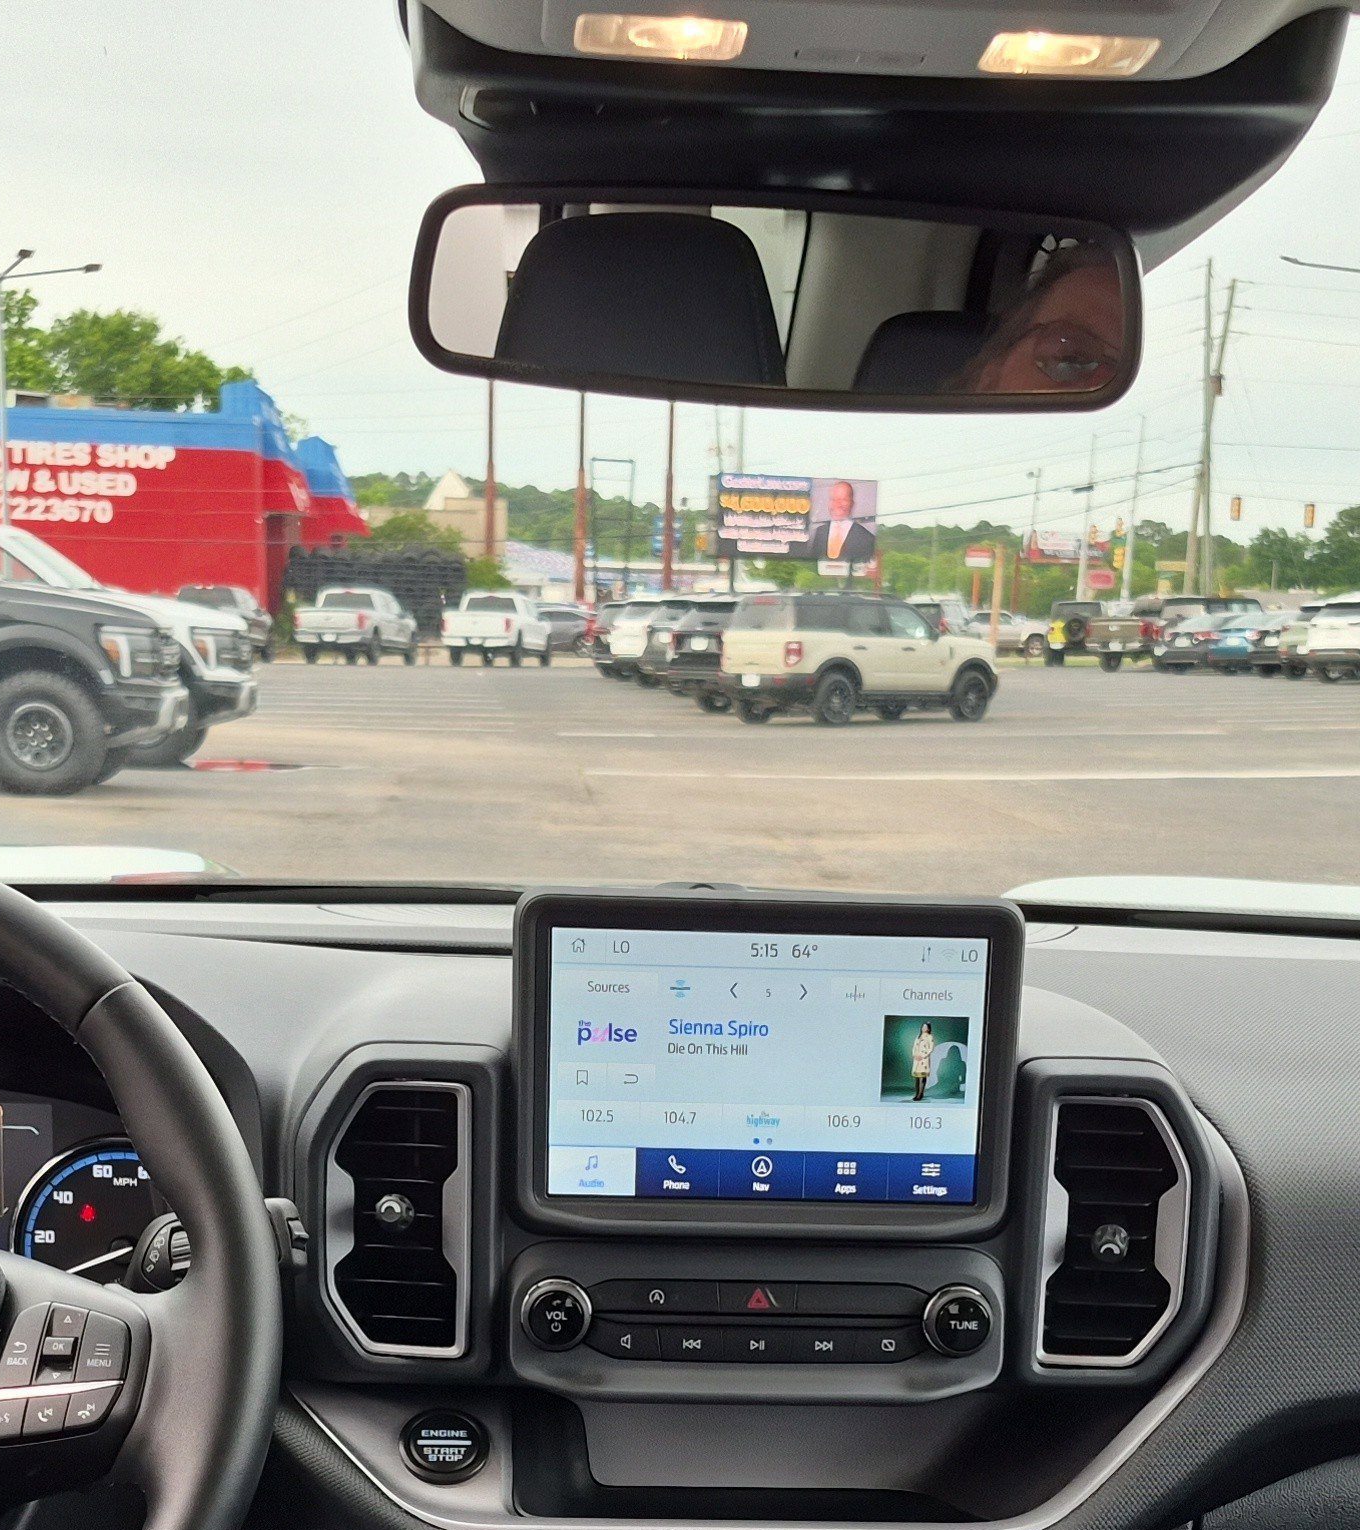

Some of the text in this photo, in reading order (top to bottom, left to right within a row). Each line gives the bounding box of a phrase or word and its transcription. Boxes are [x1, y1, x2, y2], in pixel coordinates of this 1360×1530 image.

[6, 440, 91, 466] TIRES
[97, 445, 176, 470] SHOP
[32, 469, 56, 493] &
[58, 470, 137, 496] USED
[612, 940, 630, 954] LO
[750, 943, 818, 959] 5:15 64°
[961, 949, 979, 963] LO
[587, 980, 630, 994] Sources
[902, 988, 953, 1002] Channels
[668, 1018, 769, 1039] Sienna Spiro
[667, 1042, 748, 1056] Die On This Hill
[581, 1109, 614, 1123] 102.5
[663, 1110, 697, 1124] 104.7
[746, 1114, 781, 1128] highway
[827, 1114, 861, 1128] 106.9
[910, 1116, 943, 1130] 106.3
[92, 1164, 113, 1178] 60
[113, 1178, 138, 1187] MPH
[578, 1179, 605, 1188] Audio
[663, 1180, 690, 1190] Phone
[752, 1182, 770, 1192] Nav
[834, 1184, 857, 1194] Apps
[53, 1191, 74, 1204] 40
[912, 1185, 948, 1197] Settings
[34, 1230, 56, 1244] 20
[545, 1310, 568, 1321] VOL
[949, 1320, 979, 1331] TUNE
[52, 1342, 65, 1351] OK
[6, 1358, 28, 1366] BACK
[86, 1359, 112, 1368] MENU
[421, 1429, 468, 1437] ENGINE
[423, 1447, 467, 1455] START
[428, 1454, 463, 1462] STOP
